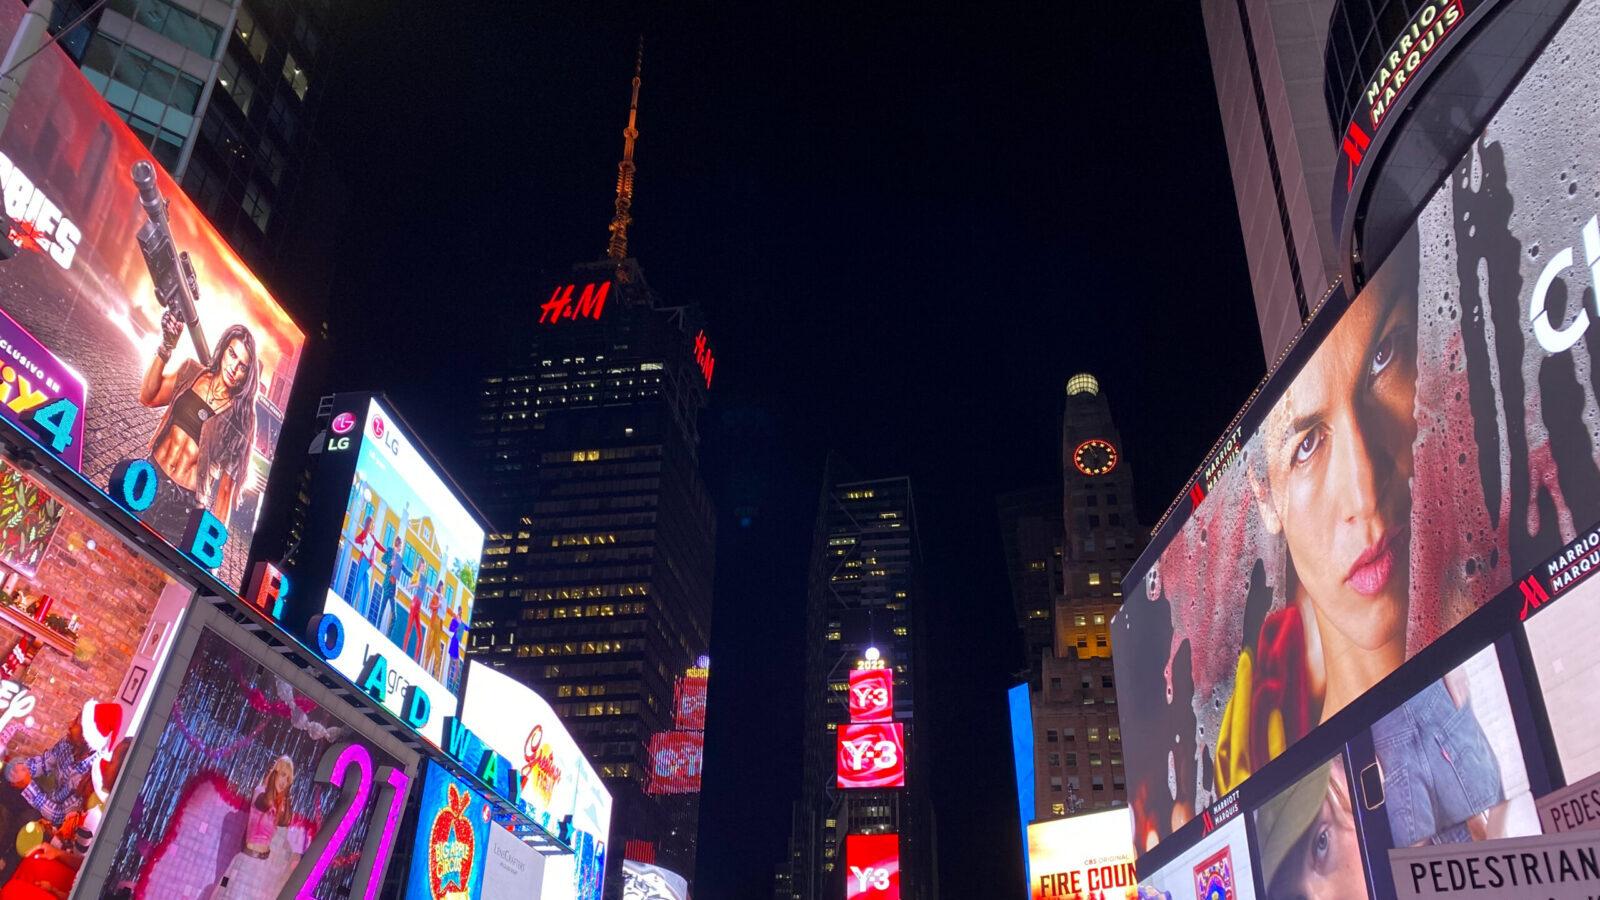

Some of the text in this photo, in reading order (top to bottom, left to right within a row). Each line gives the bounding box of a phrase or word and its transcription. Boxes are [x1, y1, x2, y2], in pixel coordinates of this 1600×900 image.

[1366, 0, 1448, 104] MARRIO
[1373, 4, 1459, 123] MARQUIS
[538, 280, 611, 325] H&M
[0, 335, 45, 380] CLUSIVO
[694, 329, 715, 389] H&M
[328, 437, 350, 451] LG
[385, 430, 400, 456] LG
[1205, 426, 1242, 480] MARRIOTT
[1548, 528, 1600, 576] MARRIO
[857, 659, 886, 671] 2022
[841, 741, 898, 771] Y-3
[1213, 790, 1240, 815] MARRIOTT
[850, 866, 890, 893] Y-3
[1040, 870, 1083, 898] FIRE
[1410, 847, 1600, 894] PEDESTRIAN
